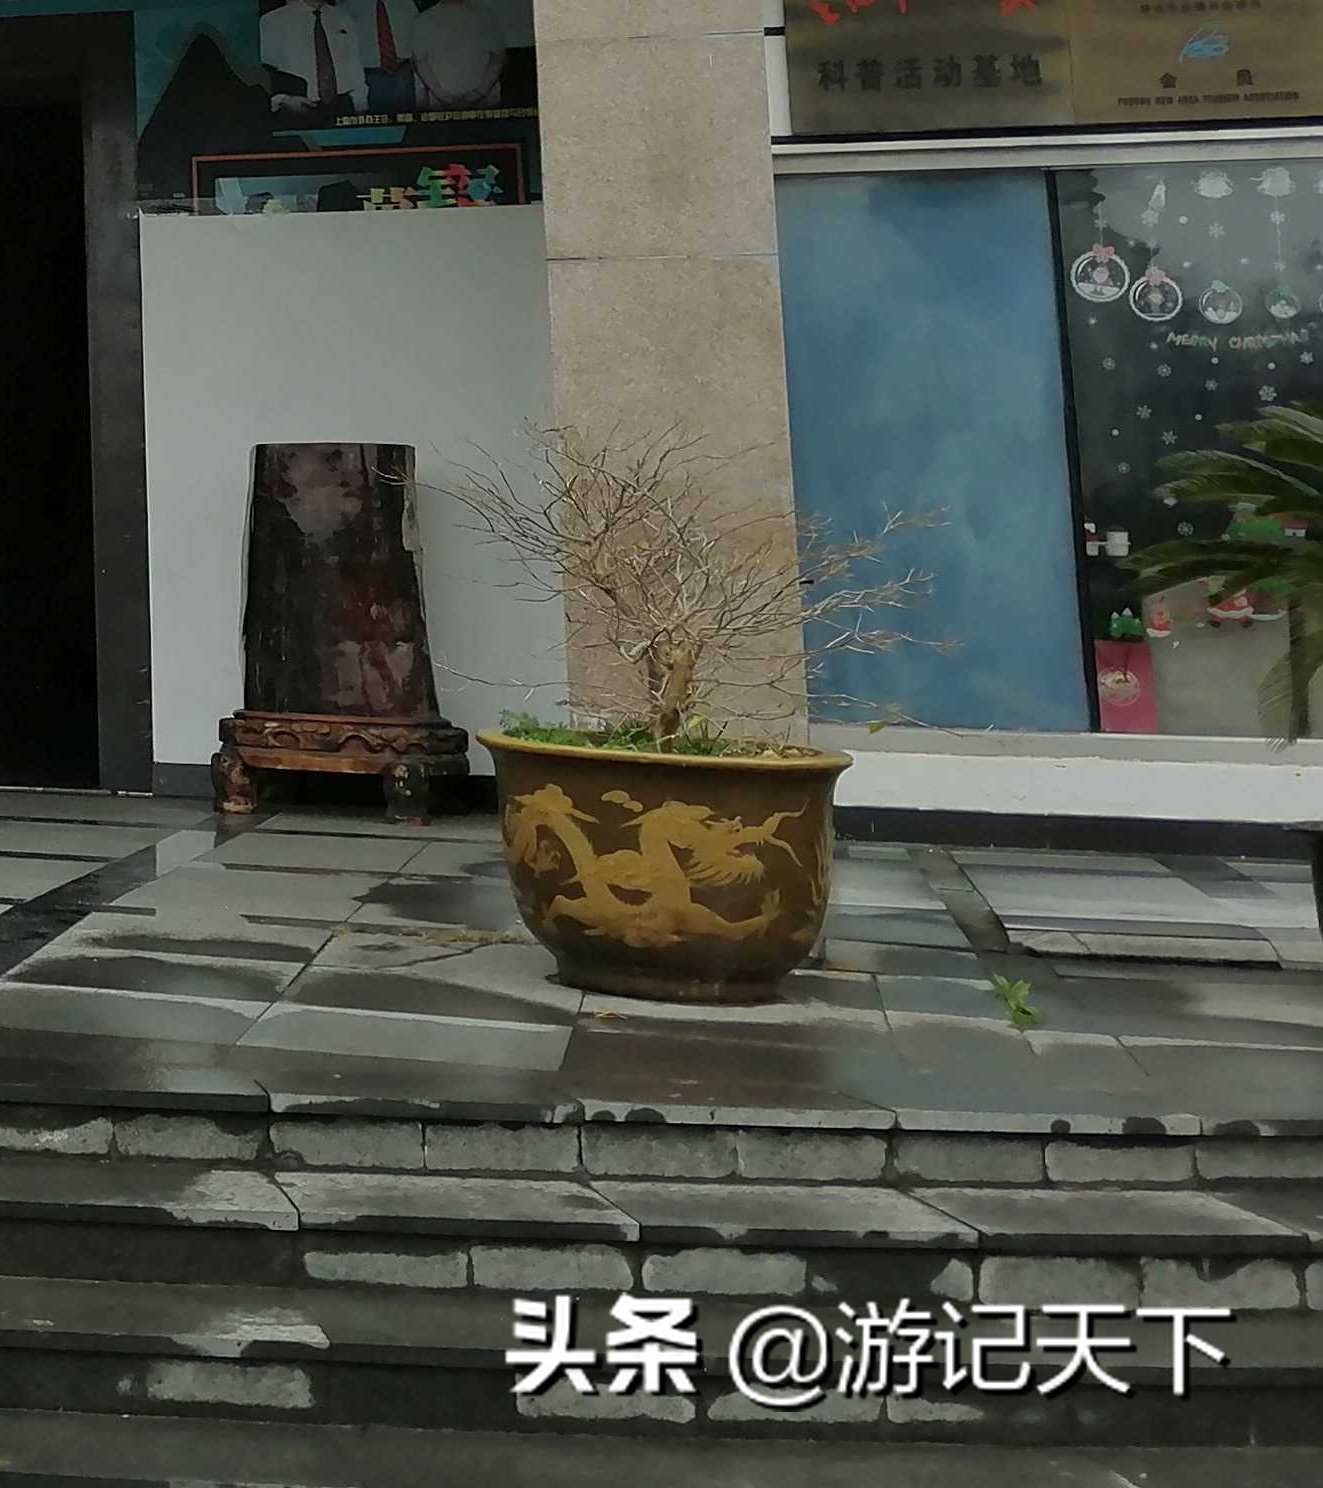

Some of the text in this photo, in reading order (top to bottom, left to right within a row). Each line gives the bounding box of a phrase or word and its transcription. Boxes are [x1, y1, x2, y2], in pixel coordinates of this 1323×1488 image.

[817, 52, 1043, 92] 科普活动基地
